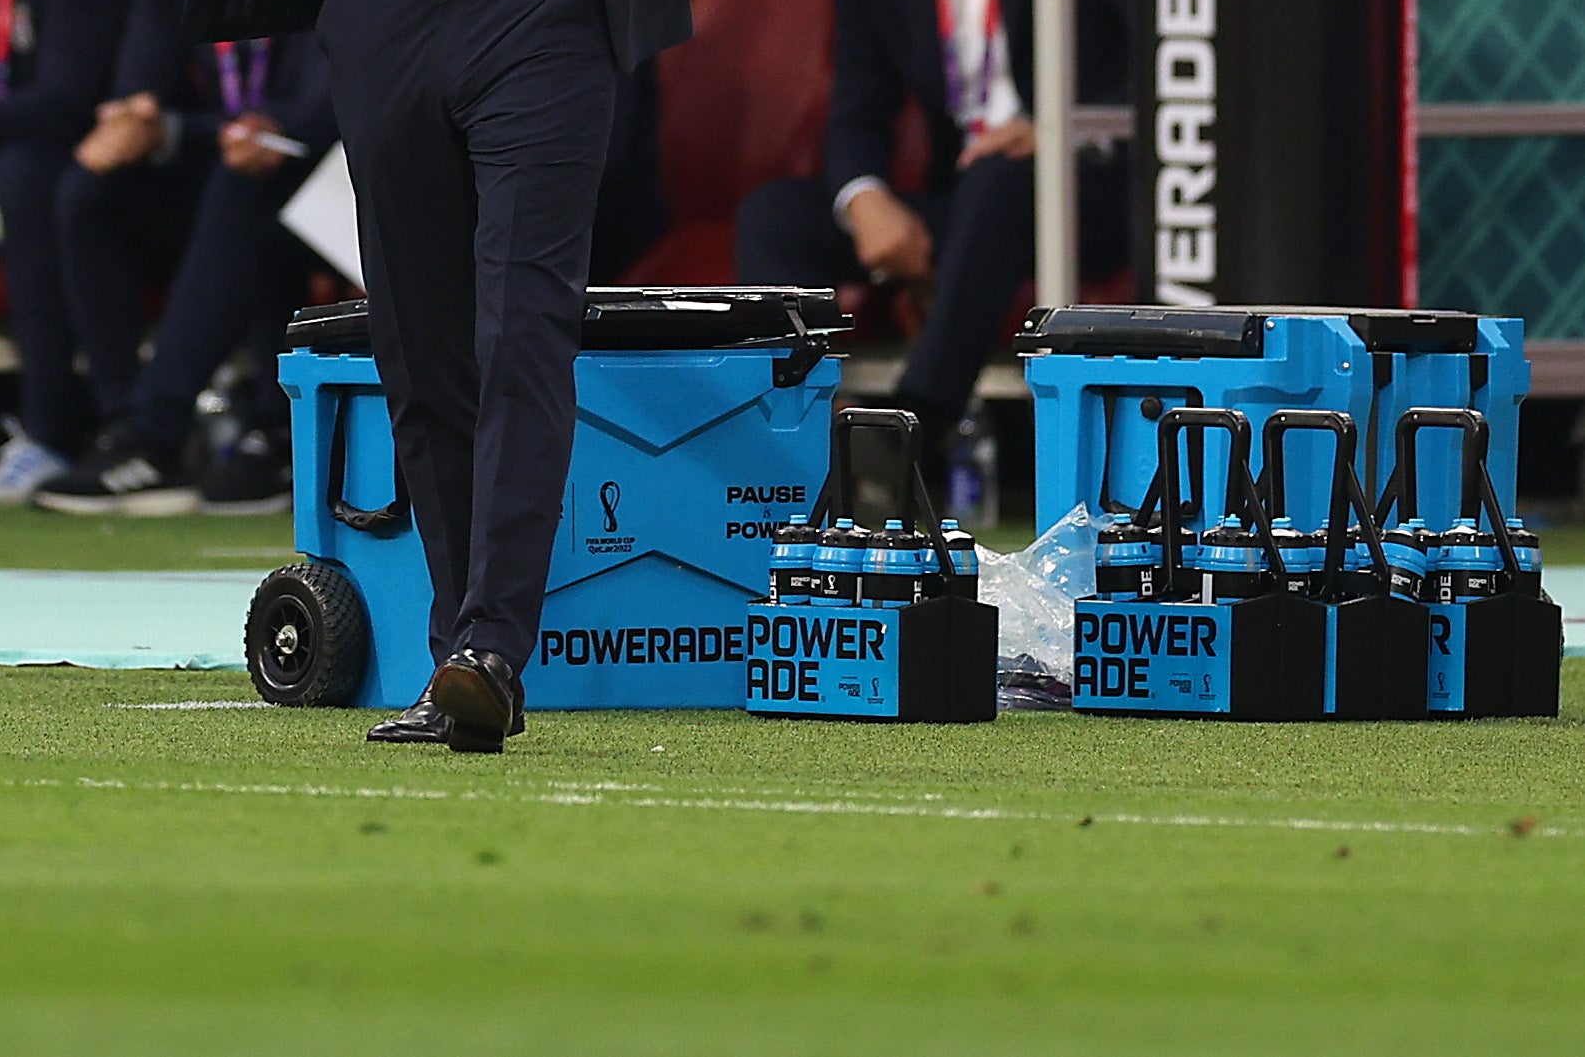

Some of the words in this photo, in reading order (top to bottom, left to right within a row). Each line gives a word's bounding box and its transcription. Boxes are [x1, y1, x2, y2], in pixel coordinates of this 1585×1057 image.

[726, 485, 806, 504] PAUSE
[726, 521, 791, 539] POW
[541, 626, 744, 666] POWERADE
[747, 615, 885, 660] POWER
[1075, 612, 1217, 657] POWER
[747, 658, 820, 702] ADE
[1074, 655, 1150, 698] ADE
